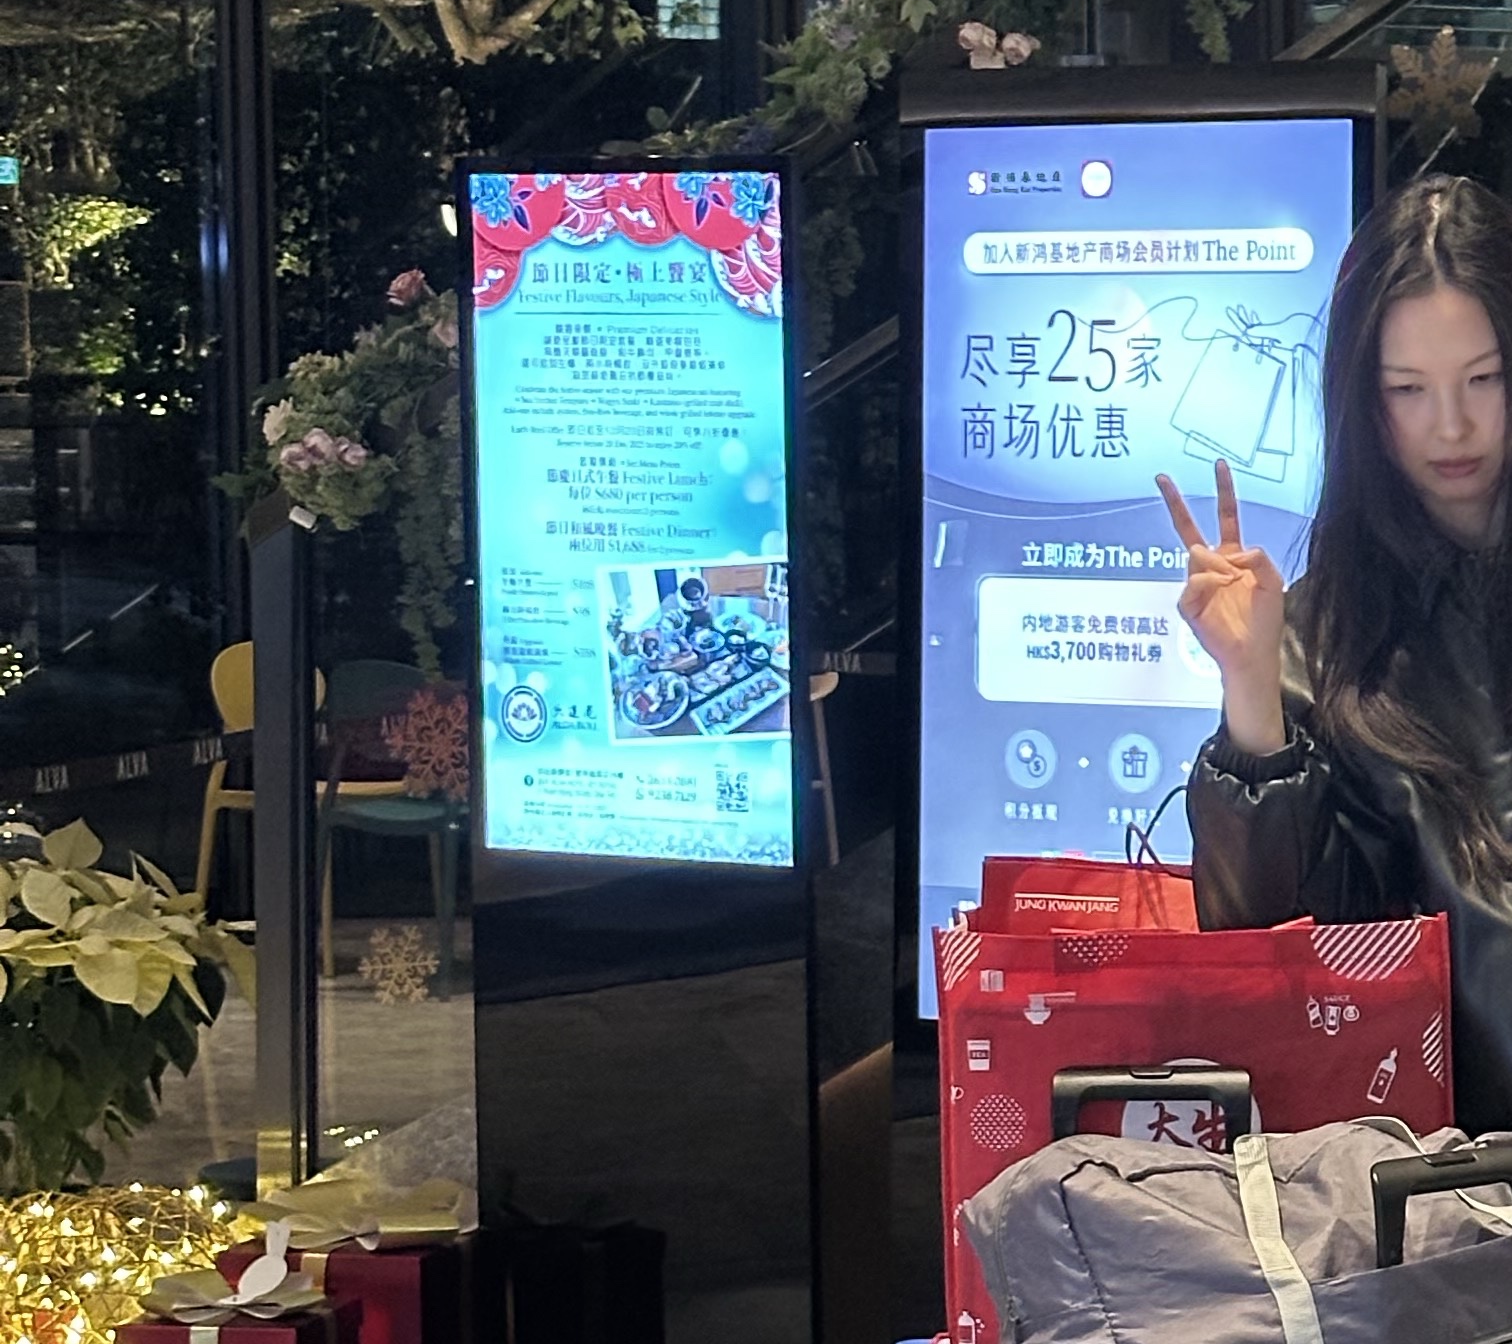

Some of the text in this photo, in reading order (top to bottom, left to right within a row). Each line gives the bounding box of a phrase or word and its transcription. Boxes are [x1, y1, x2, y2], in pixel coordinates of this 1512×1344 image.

[1203, 239, 1239, 261] The
[1246, 239, 1296, 262] Point
[961, 403, 1130, 459] 商场优惠
[1148, 546, 1190, 569] Poin
[1022, 614, 1169, 635] 内地游客免费领高达
[823, 650, 862, 672] ALVA
[1048, 899, 1086, 913] KWAN
[1087, 901, 1119, 914] JANG
